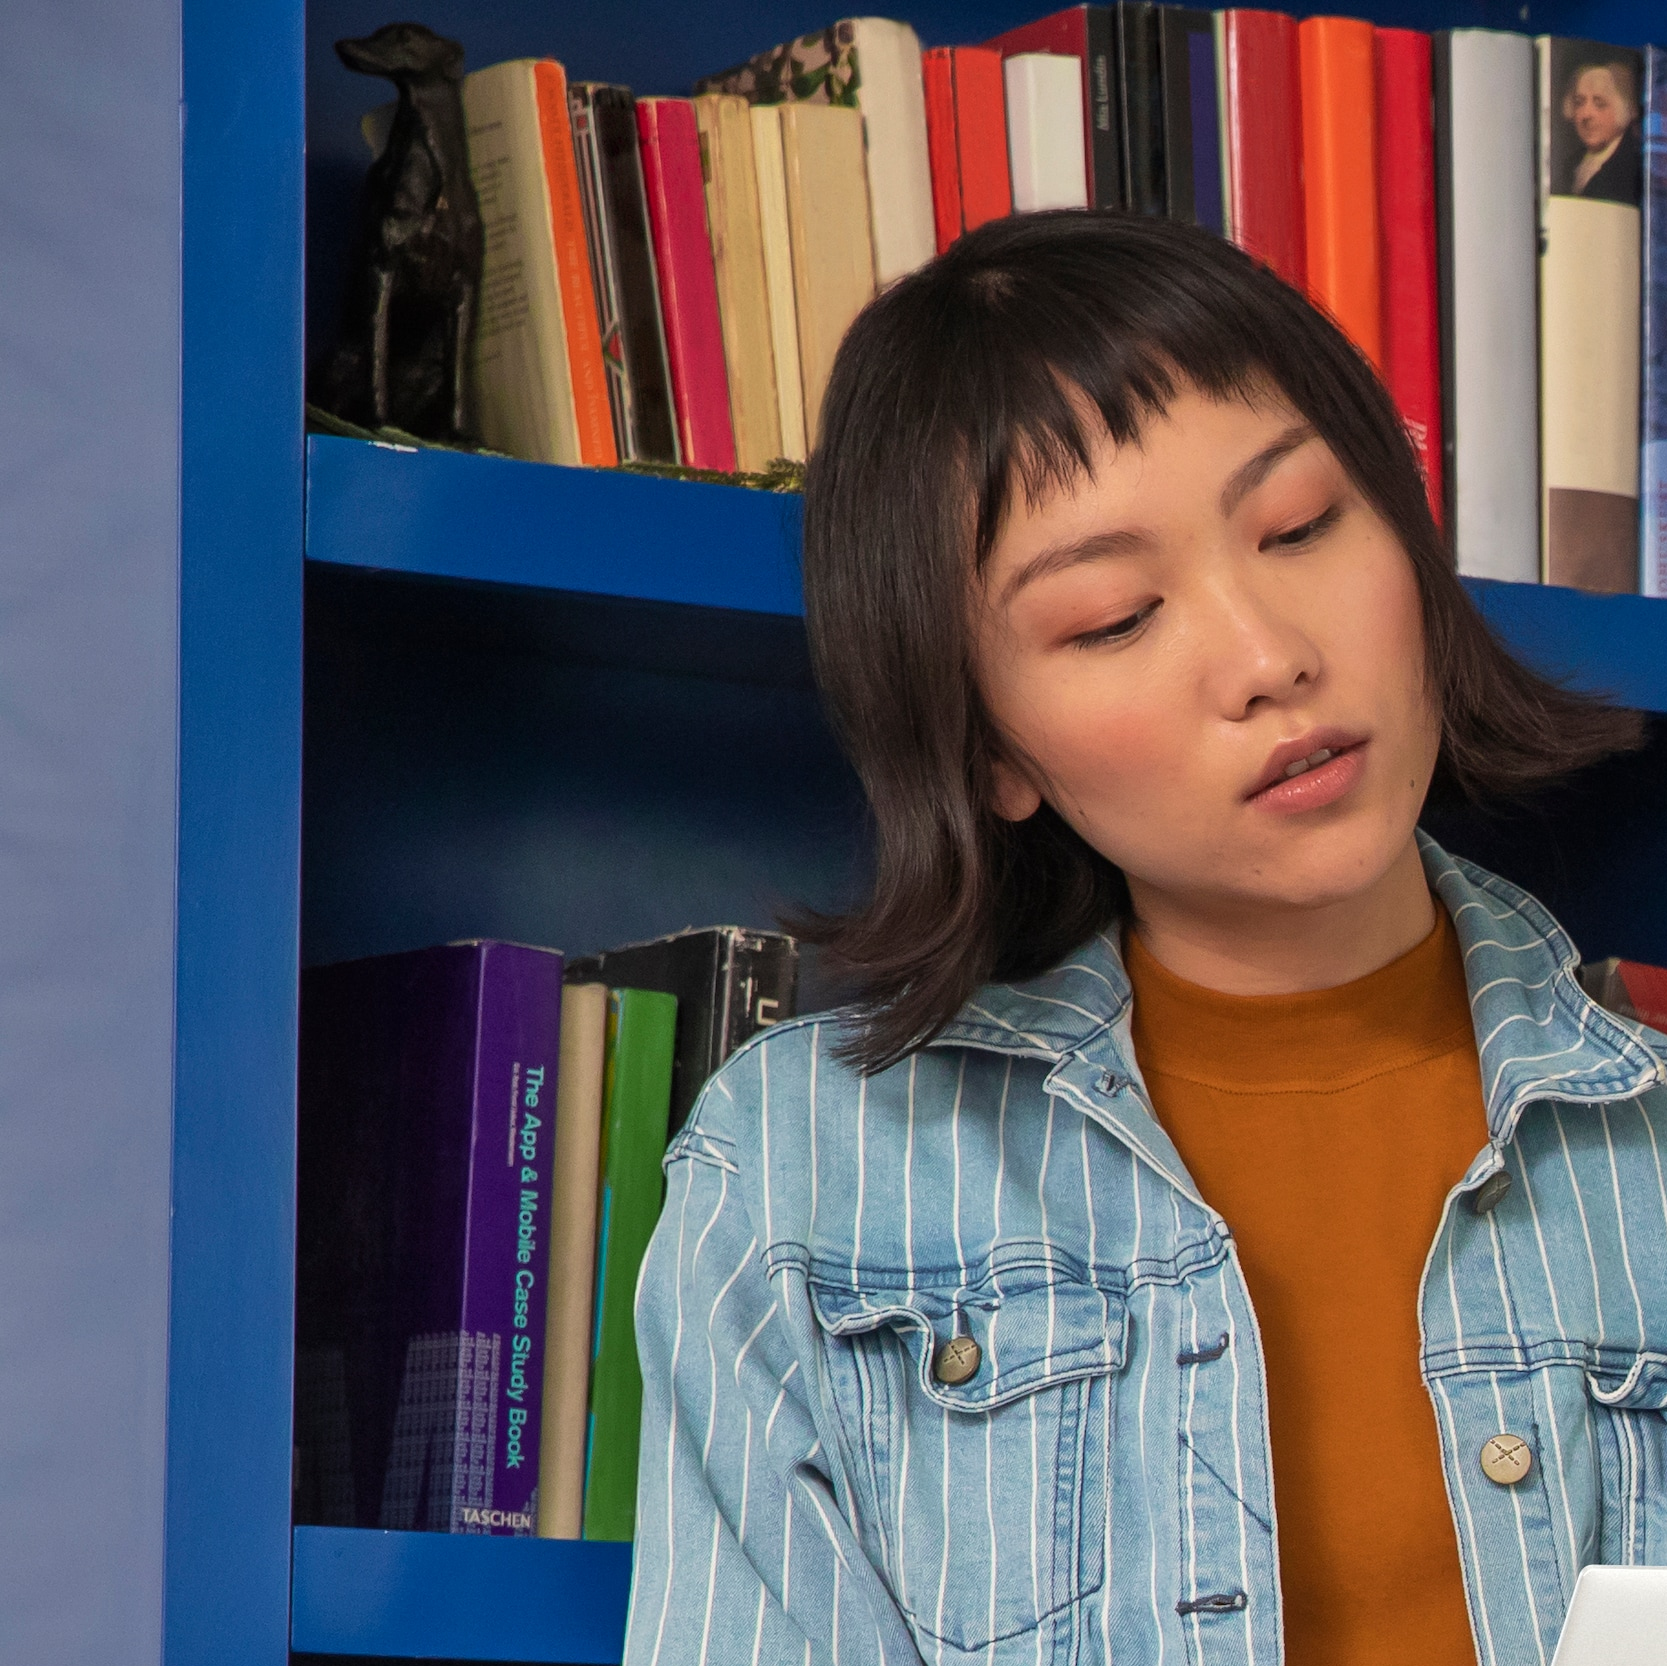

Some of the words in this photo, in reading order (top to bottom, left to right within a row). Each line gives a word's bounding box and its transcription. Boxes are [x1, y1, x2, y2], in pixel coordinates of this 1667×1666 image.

[524, 1065, 544, 1107] The
[517, 1112, 542, 1160] App
[520, 1165, 538, 1183] &
[515, 1188, 538, 1263] Mobile
[512, 1268, 534, 1328] Case
[505, 1333, 531, 1400] Study
[505, 1406, 527, 1467] Book
[463, 1507, 531, 1529] TASCHEN
